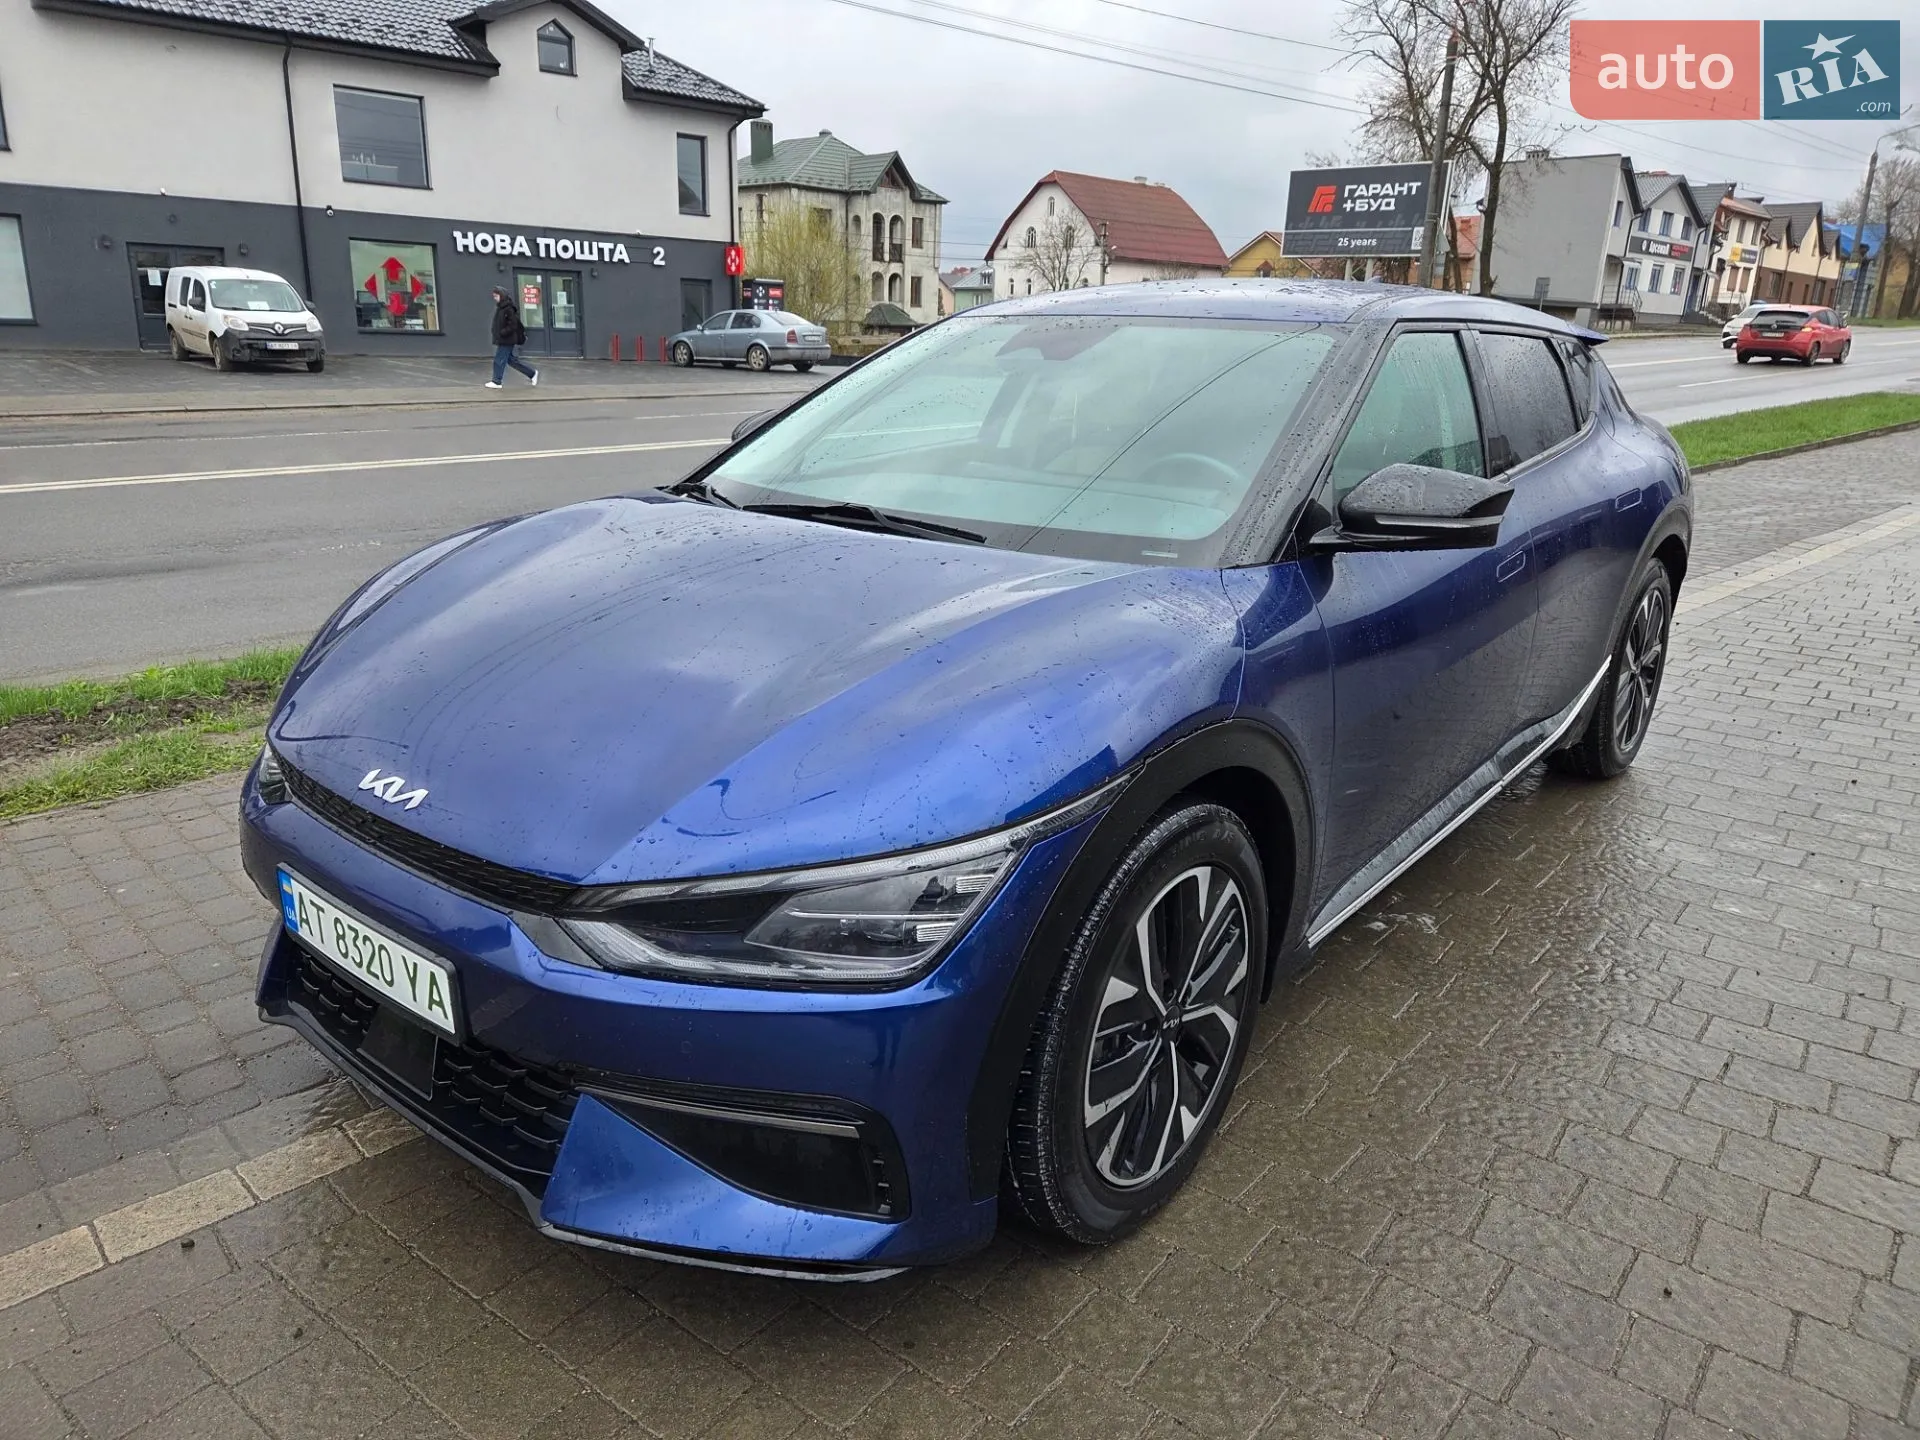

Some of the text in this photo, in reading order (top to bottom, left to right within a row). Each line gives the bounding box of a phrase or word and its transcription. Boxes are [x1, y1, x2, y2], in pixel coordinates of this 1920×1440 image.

[1344, 182, 1422, 198] ГАРАНТ
[1343, 198, 1396, 212] +БУД
[453, 231, 666, 266] НОВА ПОШТА 2
[1338, 237, 1377, 248] 25 years
[358, 769, 429, 810] KIA
[285, 906, 296, 922] UA
[298, 892, 449, 1021] AT 8320 YA
